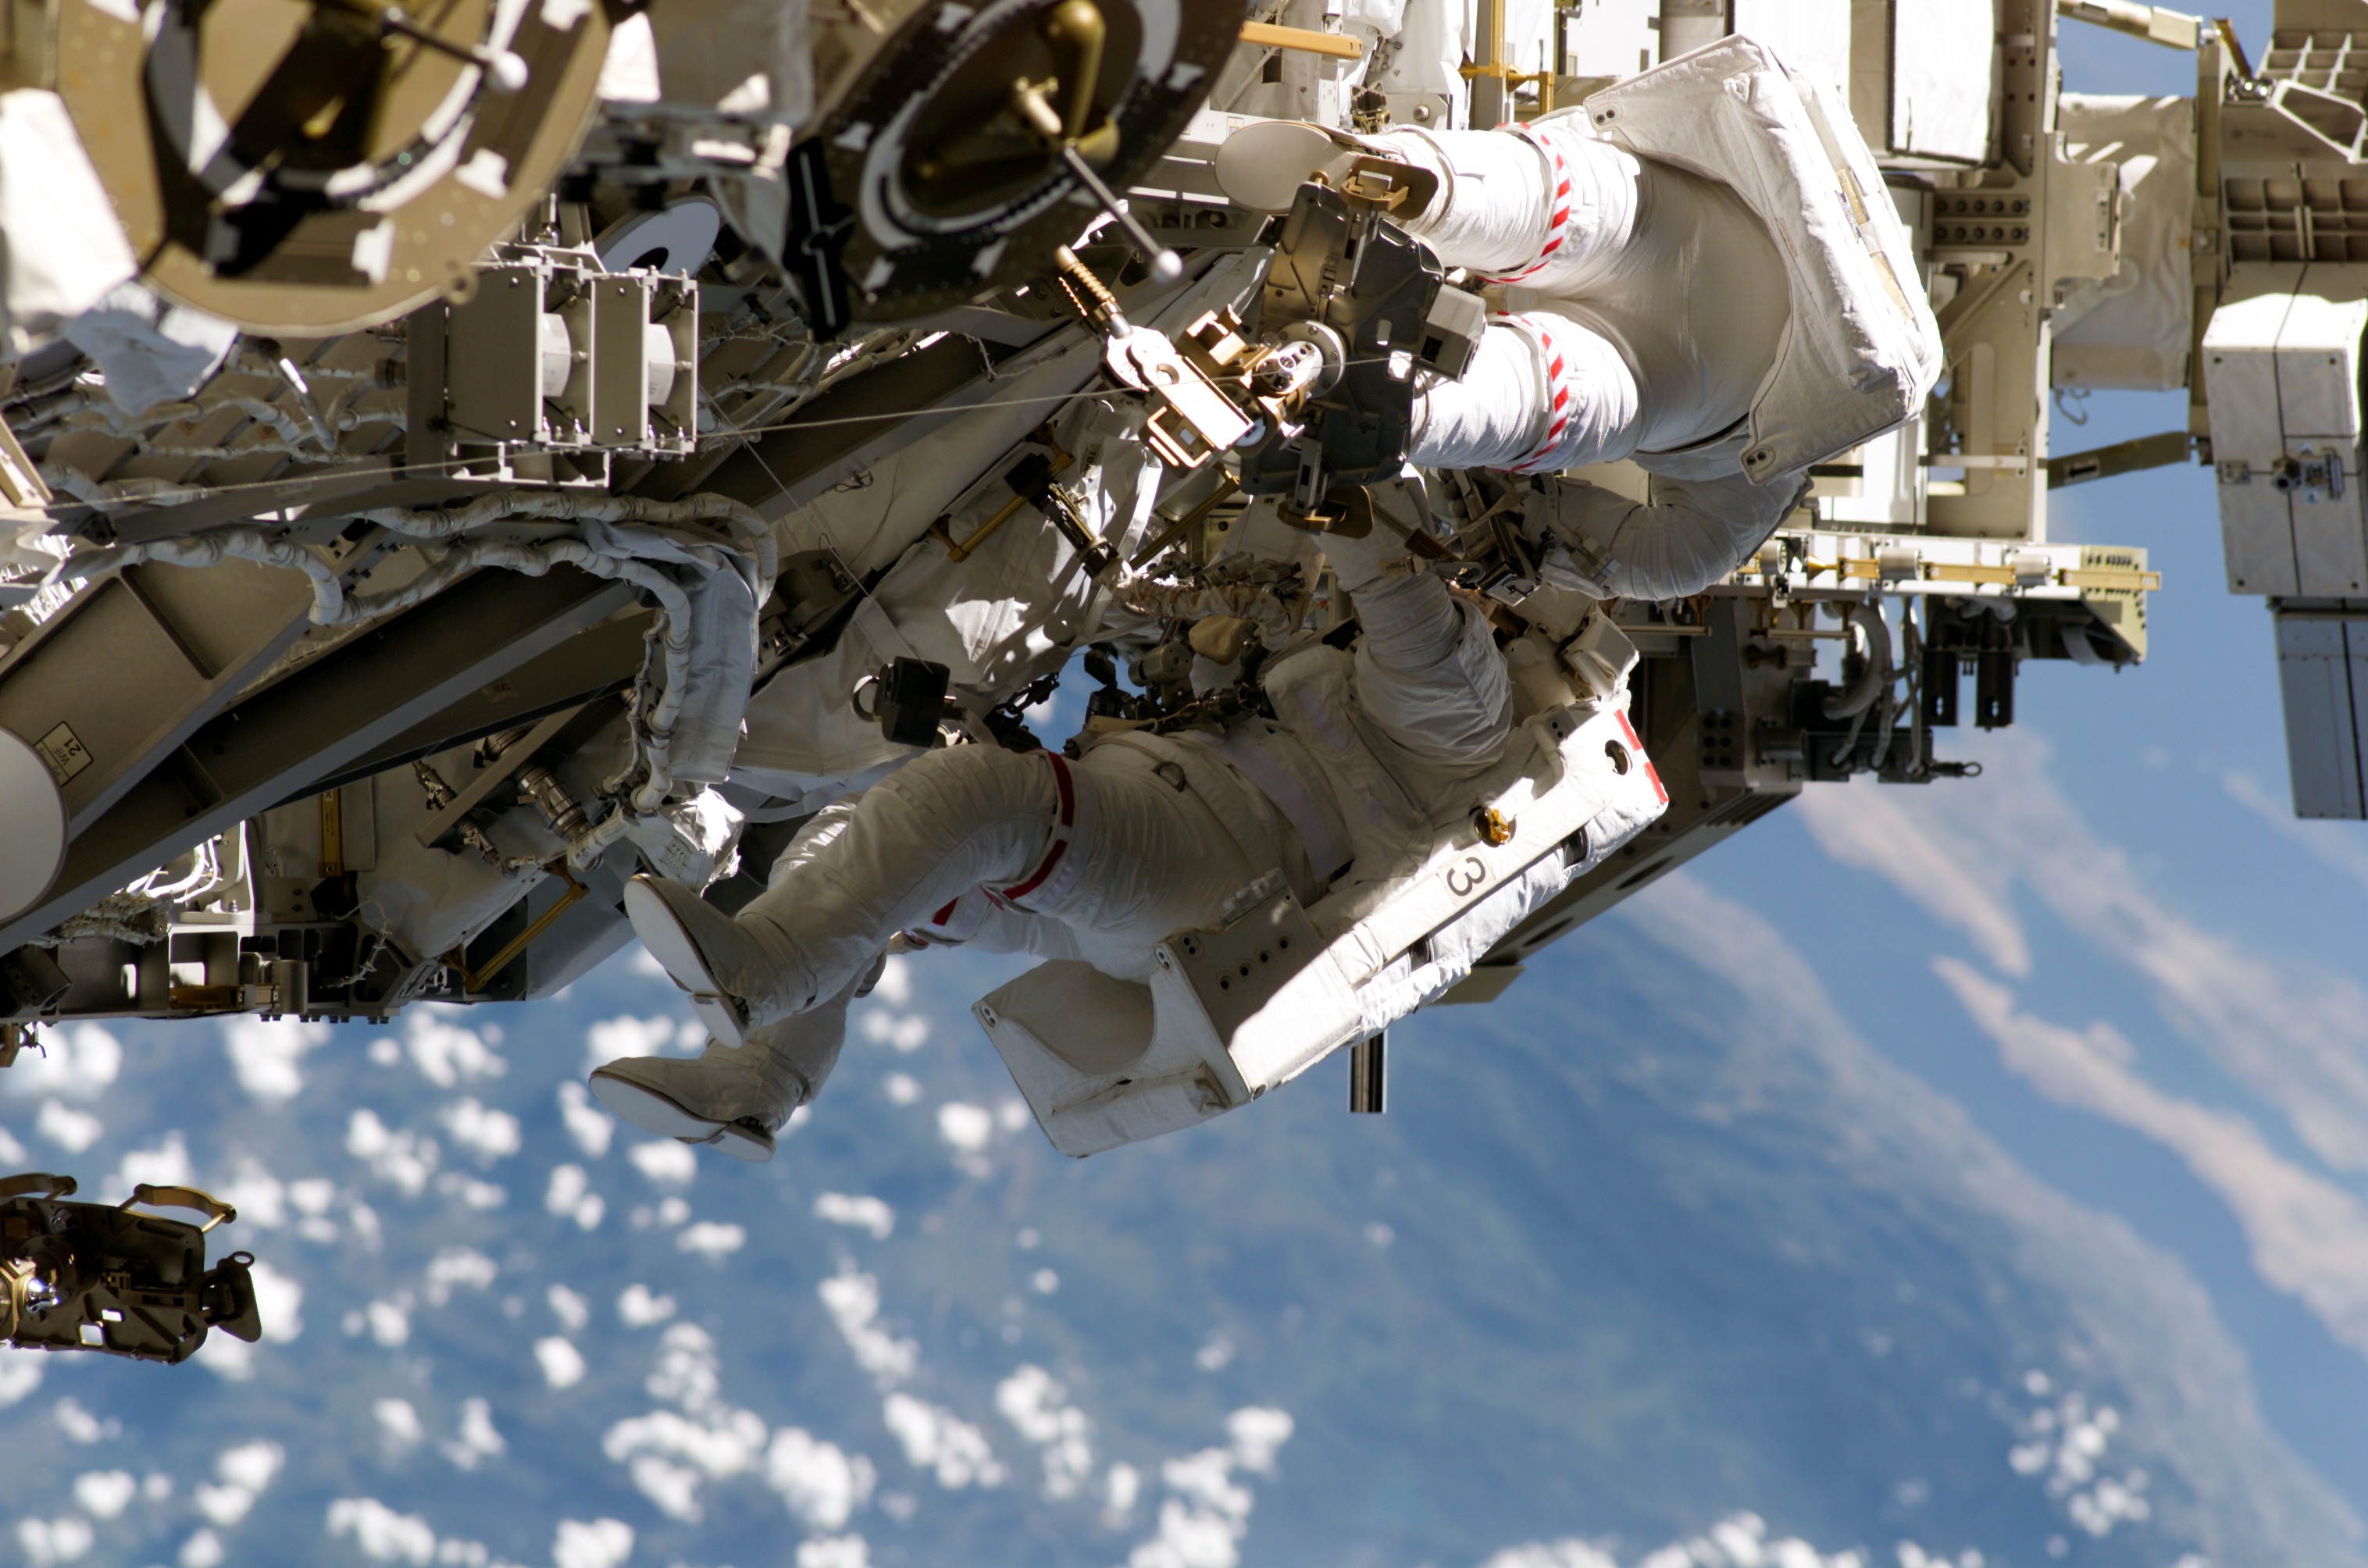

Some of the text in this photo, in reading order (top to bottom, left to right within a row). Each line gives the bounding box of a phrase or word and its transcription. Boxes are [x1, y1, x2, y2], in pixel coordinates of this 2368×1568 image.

[52, 747, 70, 766] WIF
[64, 738, 81, 757] 21
[1446, 857, 1486, 896] 3
